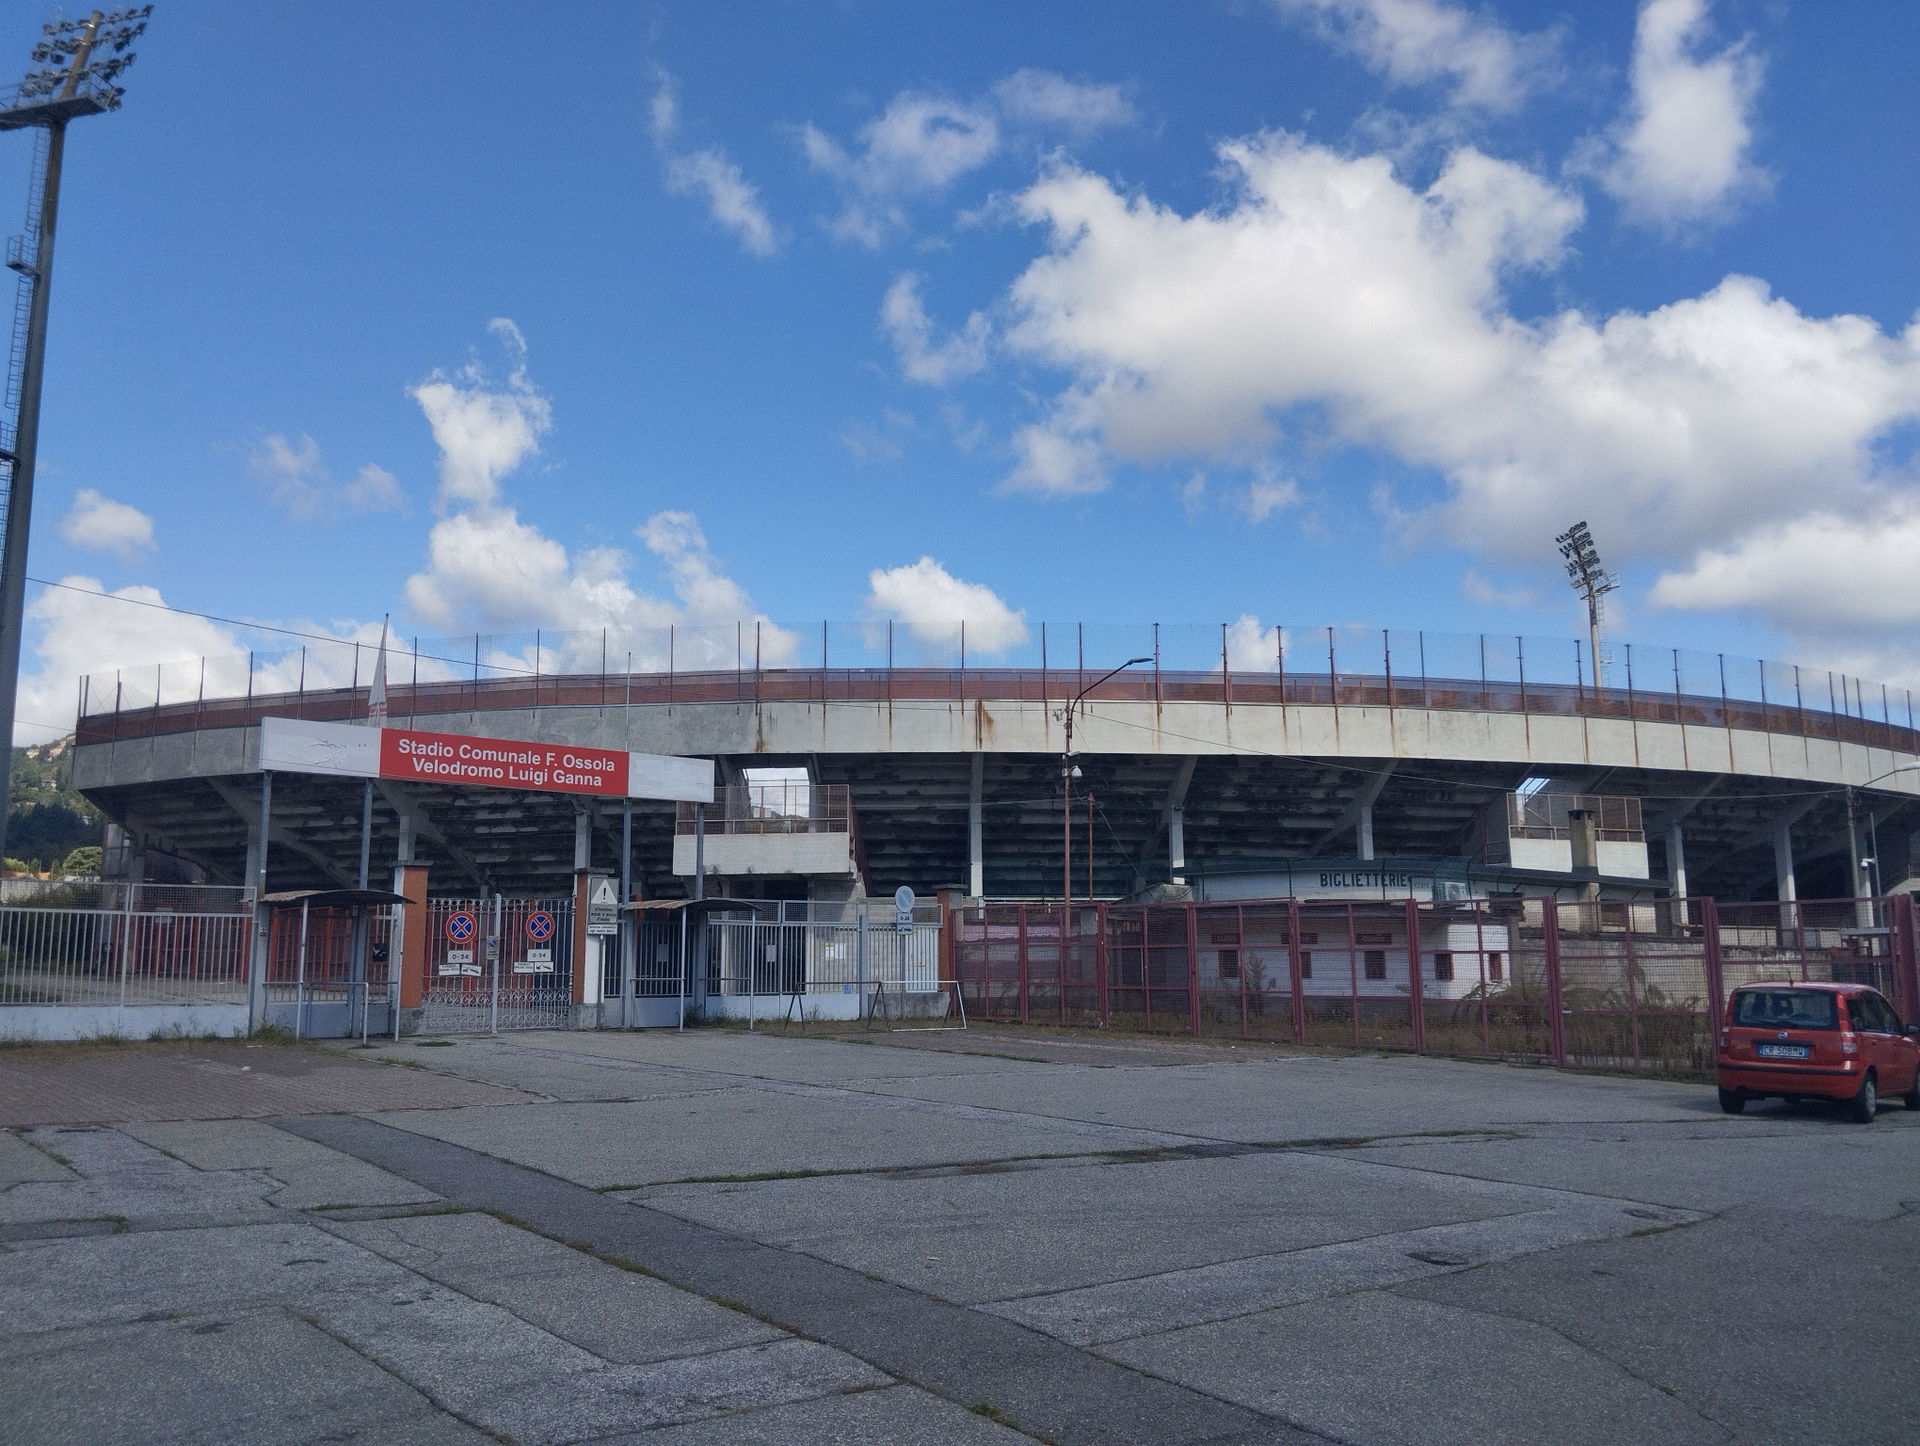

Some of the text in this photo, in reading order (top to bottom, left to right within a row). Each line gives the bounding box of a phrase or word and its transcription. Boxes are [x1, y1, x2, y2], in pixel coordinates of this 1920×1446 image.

[398, 738, 615, 772] Stadio Comunale F. Ossola
[412, 757, 602, 787] Velodromo Luigi Ganna
[1320, 873, 1407, 887] BIGLIETTERIE
